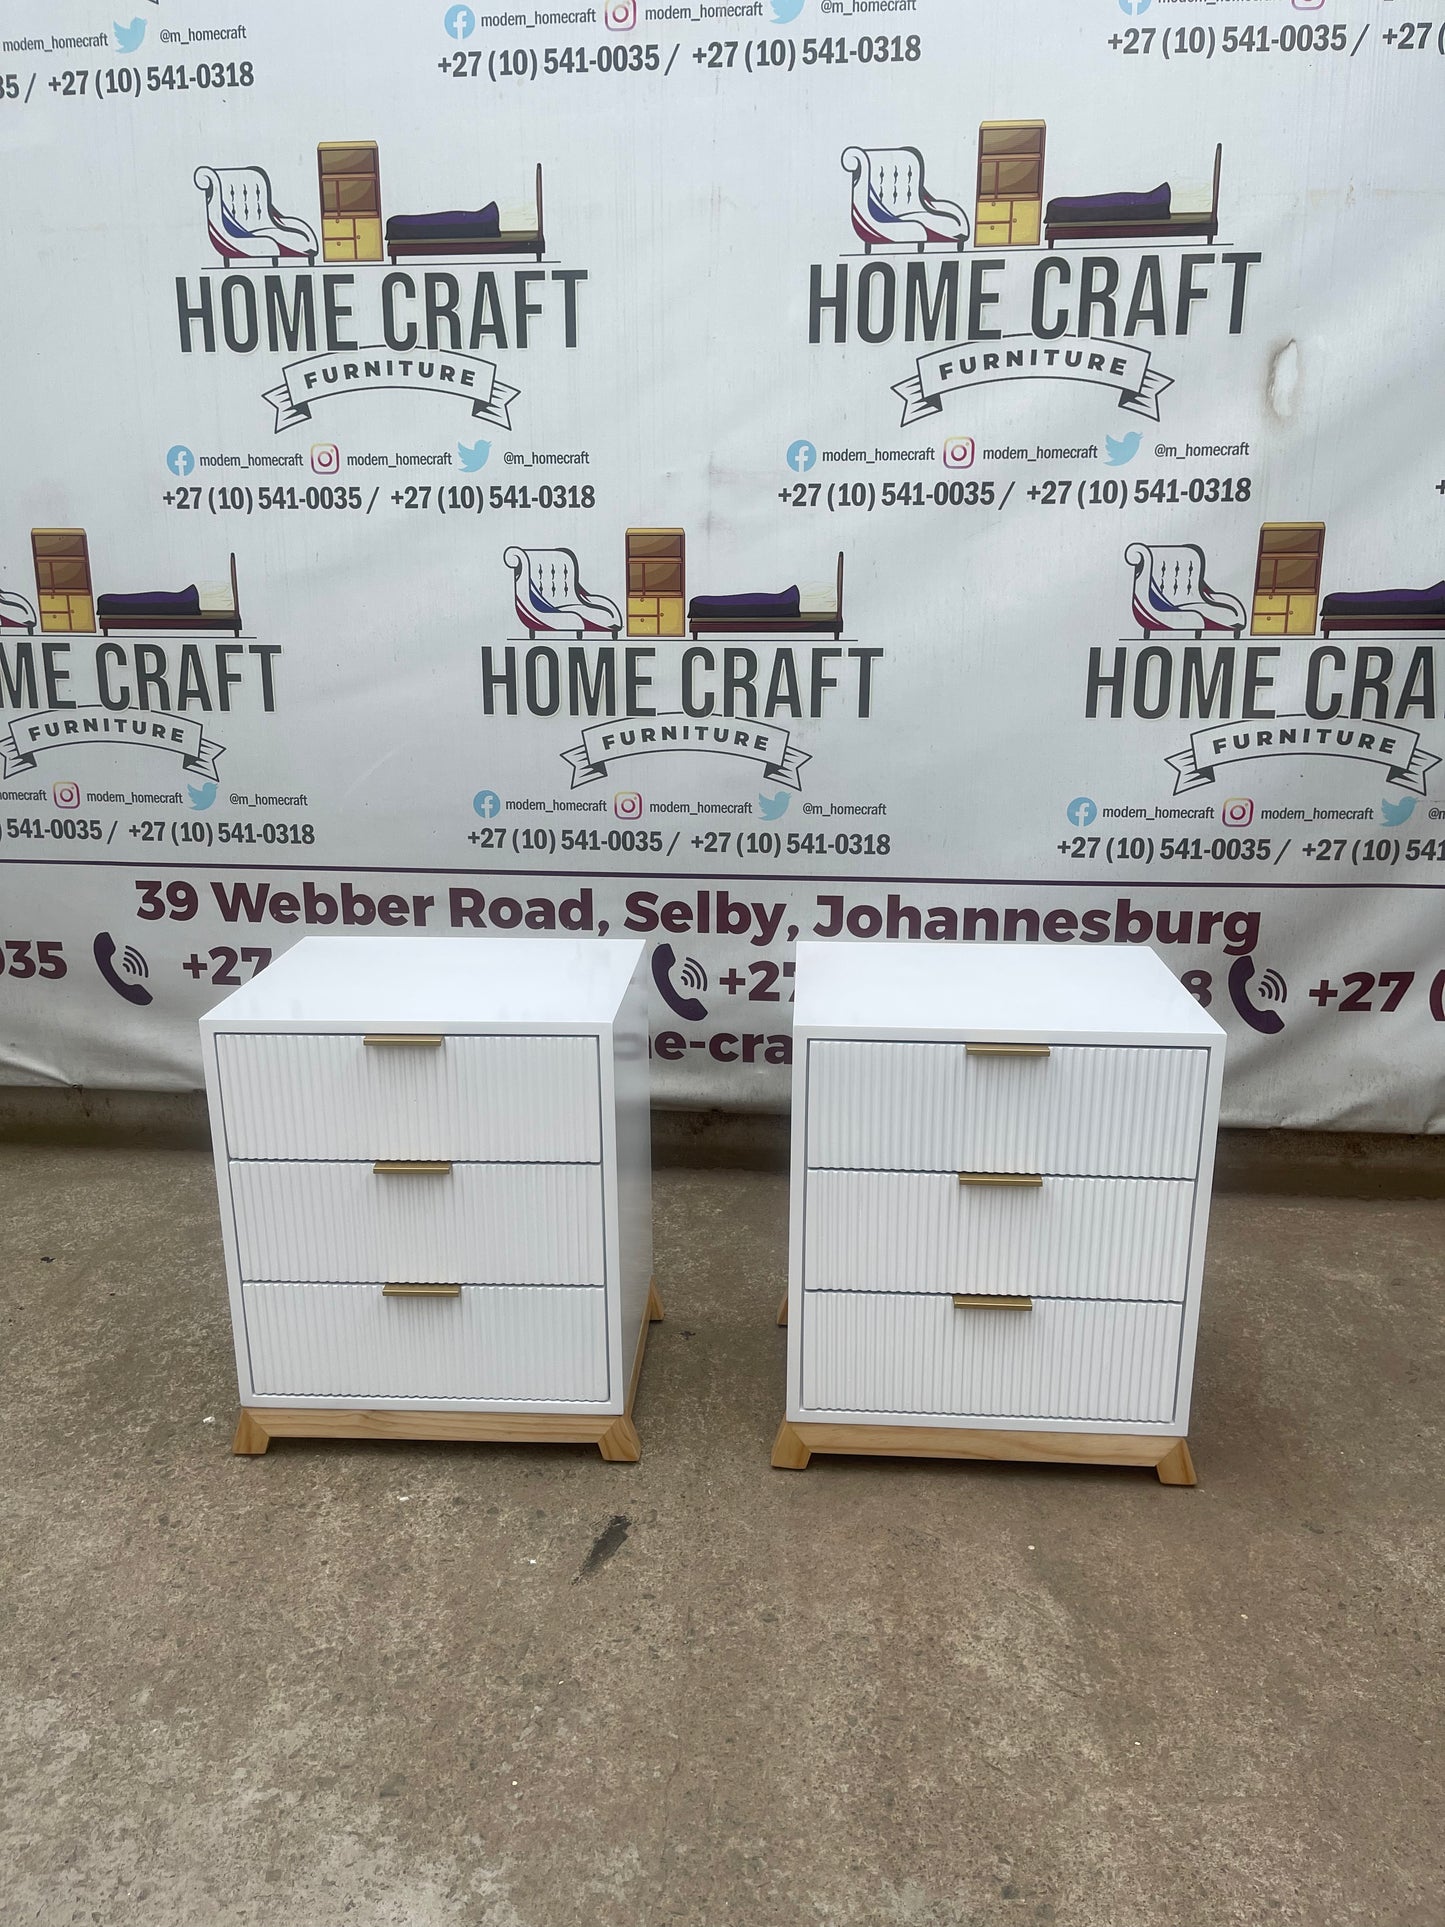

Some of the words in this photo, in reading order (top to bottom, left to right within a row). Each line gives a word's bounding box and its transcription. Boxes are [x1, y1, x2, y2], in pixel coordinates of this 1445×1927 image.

[160, 25, 247, 45] @m_homecraft
[1108, 28, 1156, 54] +27
[1163, 27, 1215, 59] (10)
[1222, 24, 1346, 52] 541-0035
[1383, 22, 1432, 49] +27
[438, 51, 482, 77] +27
[489, 49, 537, 82] (10)
[544, 44, 659, 74] 541-0035
[693, 41, 738, 68] +27
[745, 39, 795, 73] (10)
[802, 35, 921, 65] 541-0318
[48, 70, 88, 95] +27
[95, 68, 141, 99] (10)
[147, 61, 254, 91] 541-0318
[175, 274, 358, 353] HOME
[382, 270, 588, 351] CRAFT
[809, 259, 1005, 344] HOME
[1031, 252, 1262, 340] CRAFT
[304, 360, 475, 389] FURNITURE
[939, 349, 1127, 380] FURNITURE
[504, 451, 590, 467] @m_homecraft
[1155, 442, 1249, 459] @m_homecraft
[163, 487, 202, 509] +27
[209, 487, 253, 514] (10)
[258, 487, 362, 509] 541-0035
[391, 486, 431, 509] +27
[438, 486, 483, 514] (10)
[489, 485, 595, 509] 541-0318
[778, 484, 821, 506] +27
[828, 483, 875, 512] (10)
[881, 481, 995, 506] 541-0035
[1027, 481, 1072, 504] +27
[1078, 480, 1127, 509] (10)
[1134, 477, 1251, 503] 541-0318
[96, 643, 282, 712] CRAFT
[481, 646, 656, 716] HOME
[682, 647, 883, 718] CRAFT
[1085, 646, 1280, 719] HOME
[28, 718, 184, 743] FURNITURE
[602, 726, 768, 751] FURNITURE
[1213, 729, 1396, 754] FURNITURE
[230, 793, 308, 807] @m_homecraft
[803, 803, 887, 817] @m_homecraft
[7, 818, 102, 840] 541-0035
[129, 821, 165, 841] +27
[172, 822, 213, 847] (10)
[218, 823, 315, 844] 541-0318
[468, 828, 506, 848] +27
[512, 829, 555, 854] (10)
[561, 830, 662, 851] 541-0035
[691, 832, 731, 852] +27
[737, 833, 781, 858] (10)
[787, 833, 890, 855] 541-0318
[1057, 837, 1101, 858] +27
[1106, 837, 1154, 864] (10)
[1160, 838, 1271, 860] 541-0035
[1302, 839, 1347, 860] +27
[1352, 839, 1400, 865] (10)
[135, 880, 198, 921] 39
[210, 882, 434, 926] Webber
[449, 888, 609, 936] Road,
[624, 890, 799, 946] Selby,
[813, 894, 1261, 957] Johannesburg
[0, 940, 67, 979] 35
[1309, 971, 1415, 1012] +27
